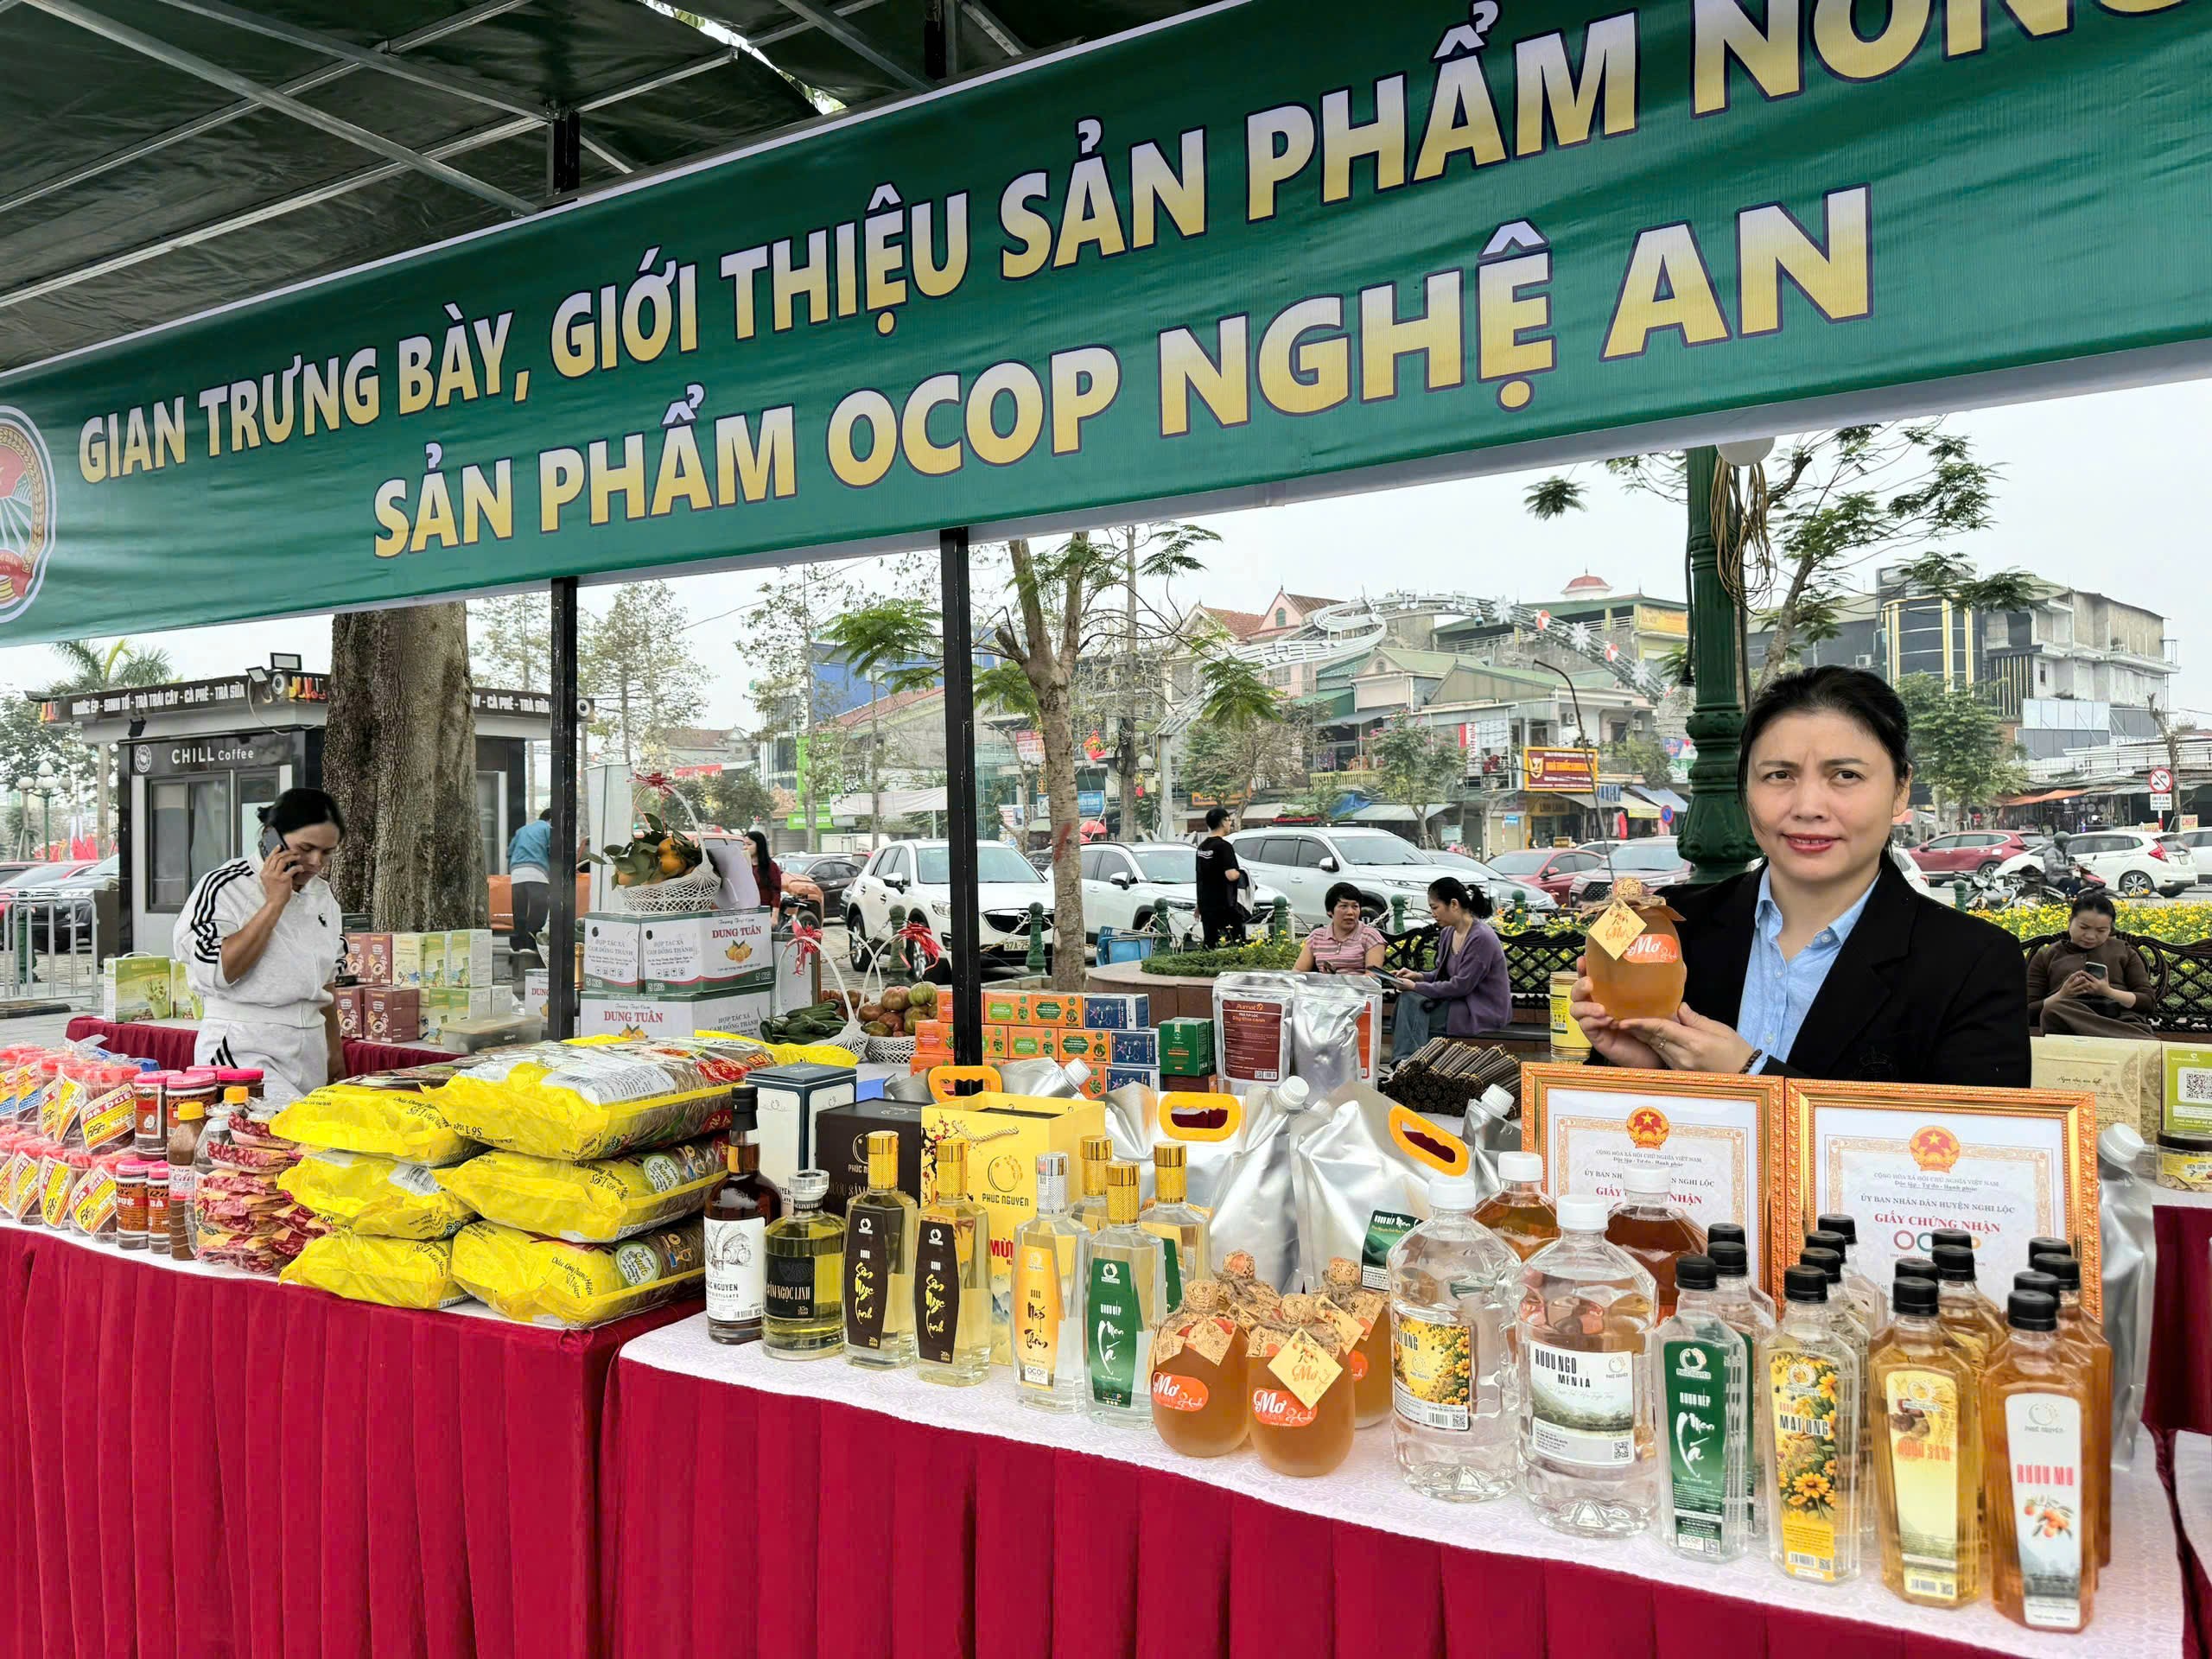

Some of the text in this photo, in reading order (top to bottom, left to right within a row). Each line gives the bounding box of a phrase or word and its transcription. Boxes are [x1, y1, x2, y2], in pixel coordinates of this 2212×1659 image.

[79, 395, 186, 484] GIAN
[199, 347, 380, 458] TRƯNG
[397, 303, 531, 416] BÀY,
[550, 249, 698, 378] GIỚI
[720, 181, 970, 337] THIỆU
[999, 116, 1207, 281] SẢN
[1245, 0, 1640, 224] PHẨM
[374, 182, 1874, 558] SẢN PHẨM OCOP NGHỆ AN
[214, 683, 229, 700] TRÀ
[171, 746, 254, 764] CHILL Coffee
[712, 928, 738, 939] DUNG
[1005, 940, 1030, 950] 37A-25
[1626, 935, 1661, 955] Mơ
[604, 1010, 663, 1023] DUNG TUÂN
[1700, 1179, 1714, 1188] LỘC
[1596, 1184, 1702, 1206] GIẤY NHẬN
[1893, 1197, 1916, 1205] NHÂN
[1919, 1198, 1937, 1207] DÂN
[1940, 1201, 1969, 1211] HUYỆN
[1972, 1204, 1994, 1212] NGHI
[1997, 1205, 2015, 1214] LỘC
[1874, 1210, 2001, 1234] GIẤY CHỨNG NHẬN
[778, 1286, 810, 1303] NGỌC LINH
[1153, 1372, 1179, 1396] Mơ
[1558, 1374, 1577, 1387] MEN
[1253, 1389, 1287, 1413] Mơ
